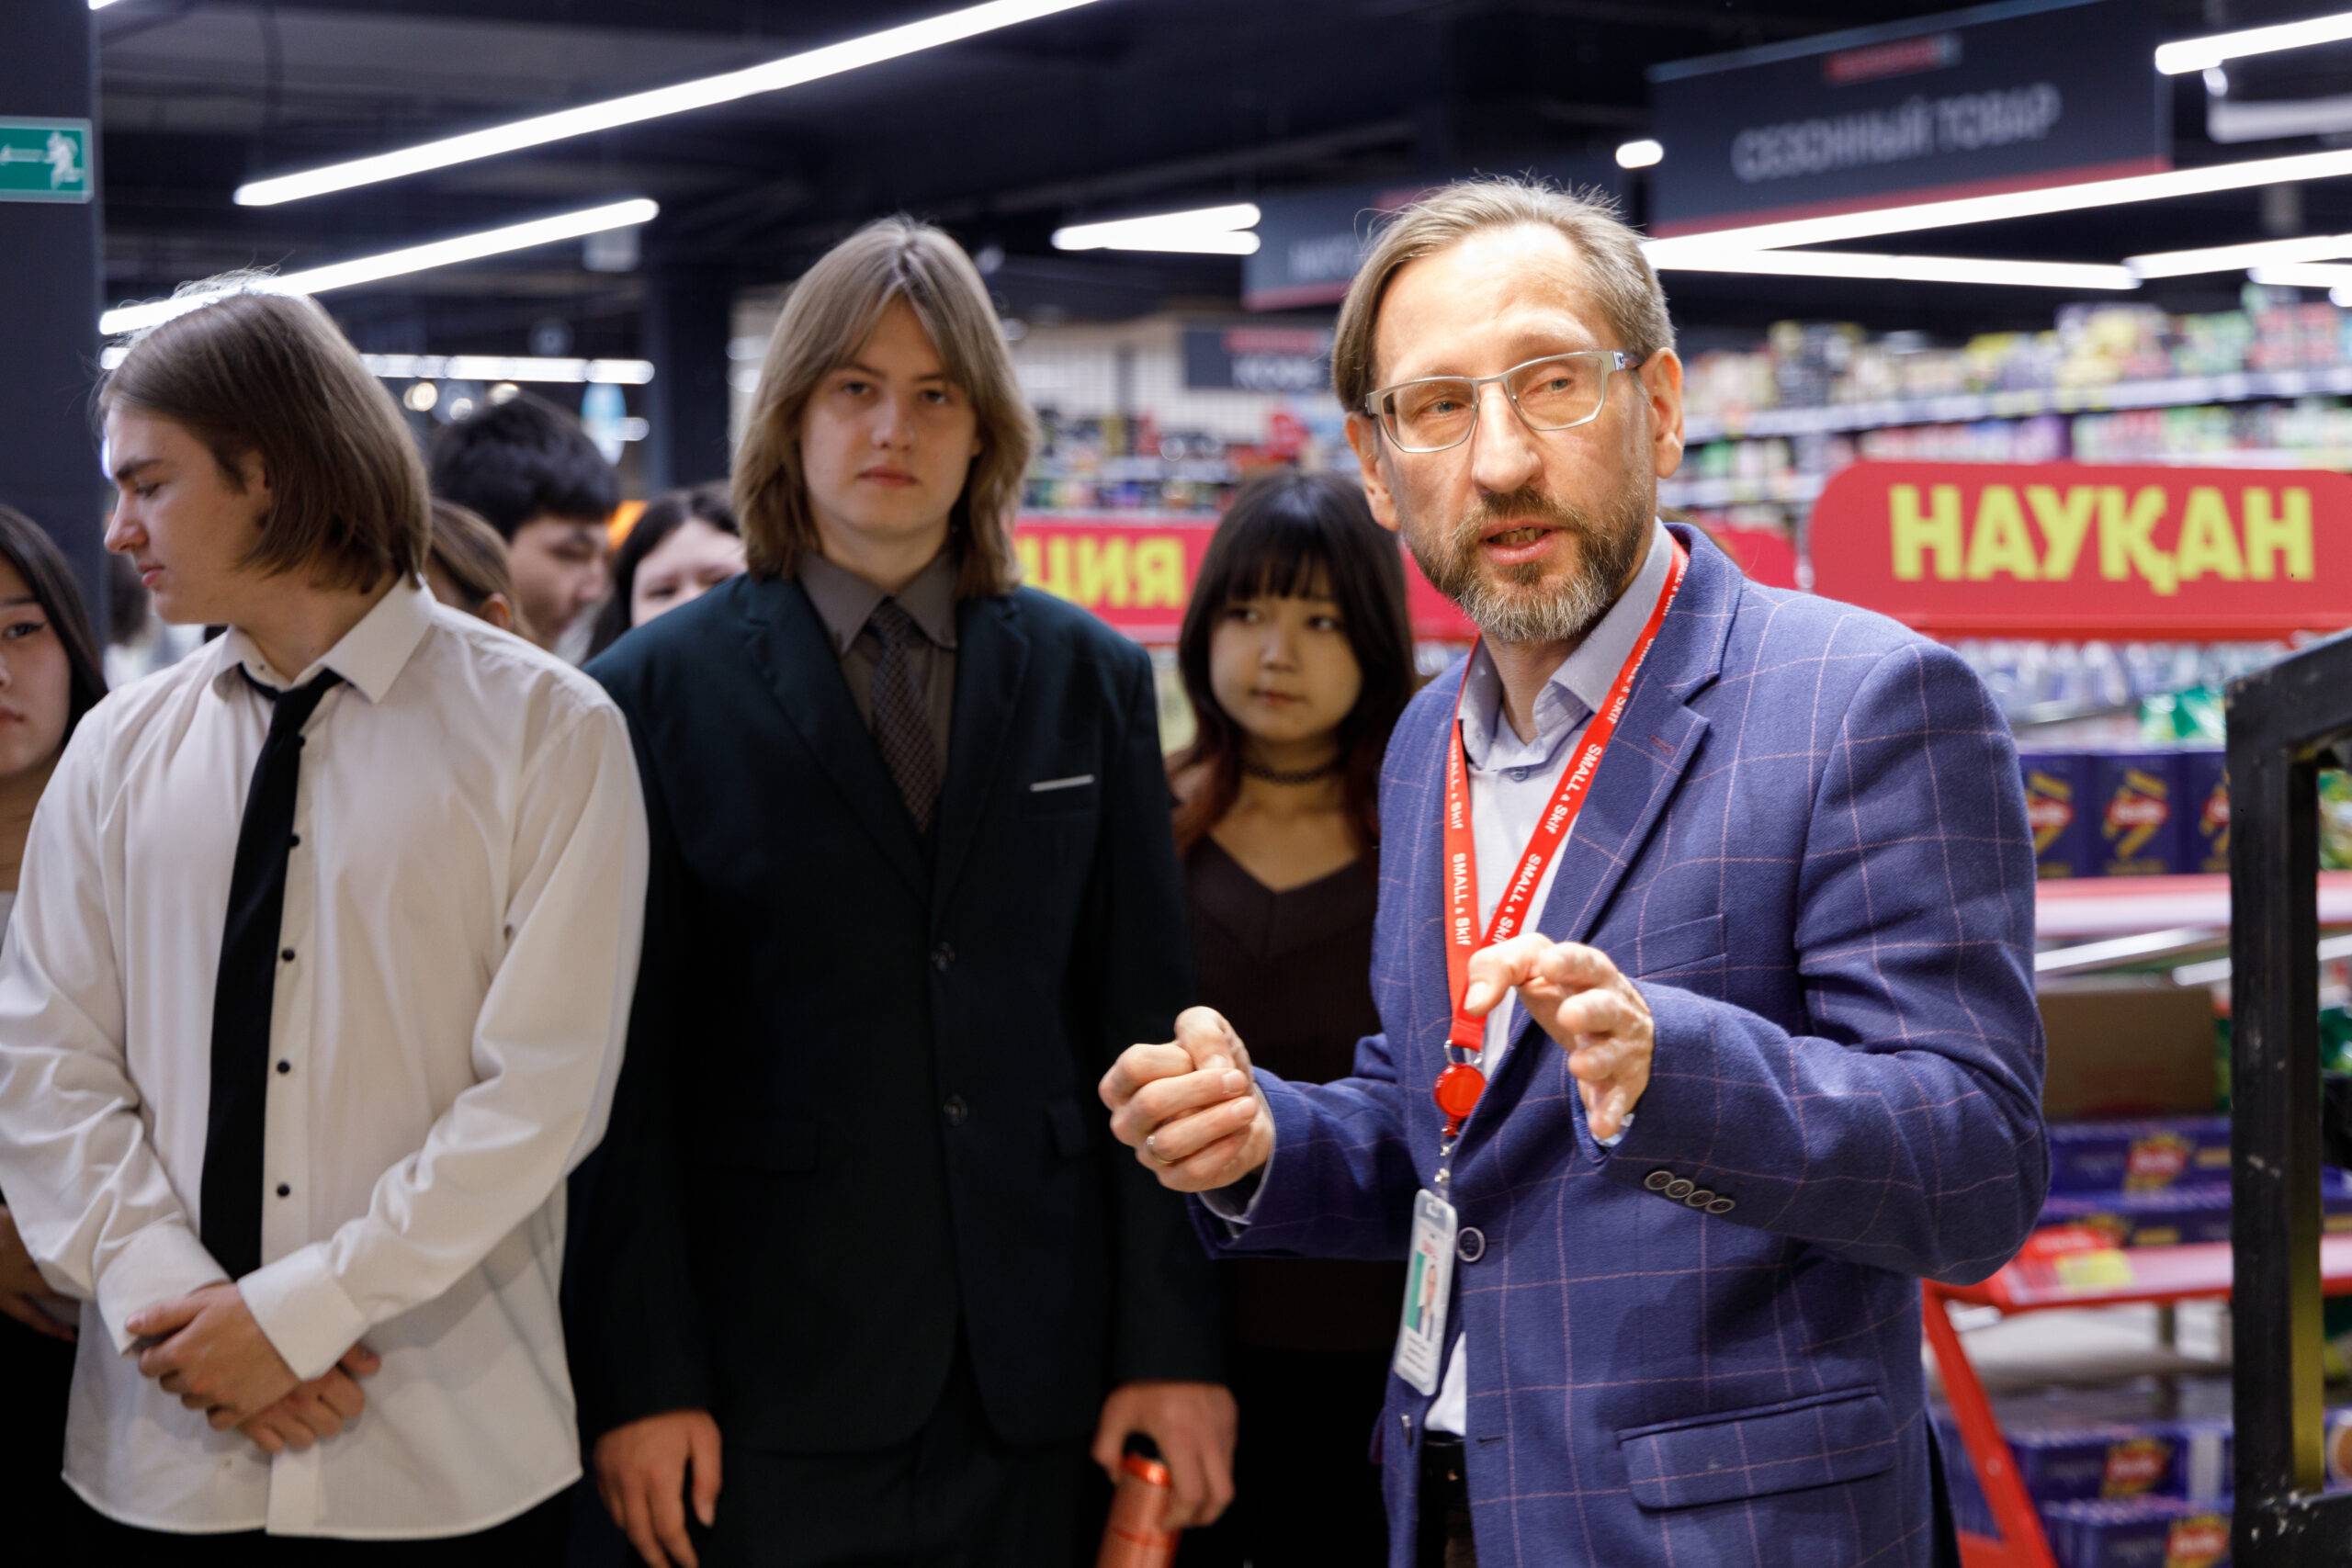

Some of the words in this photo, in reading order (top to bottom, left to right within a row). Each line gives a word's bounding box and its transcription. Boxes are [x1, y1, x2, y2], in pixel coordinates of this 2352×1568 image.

[1732, 96, 1933, 183] СЕЗОННЫЙ
[1935, 84, 2062, 152] ТОВАР
[1889, 484, 2314, 596] НАУҚАН
[1016, 536, 1185, 609] ЦИЯ
[1565, 744, 1602, 791] SMALL
[1453, 852, 1468, 905] SMALL
[1509, 853, 1542, 902] SMALL
